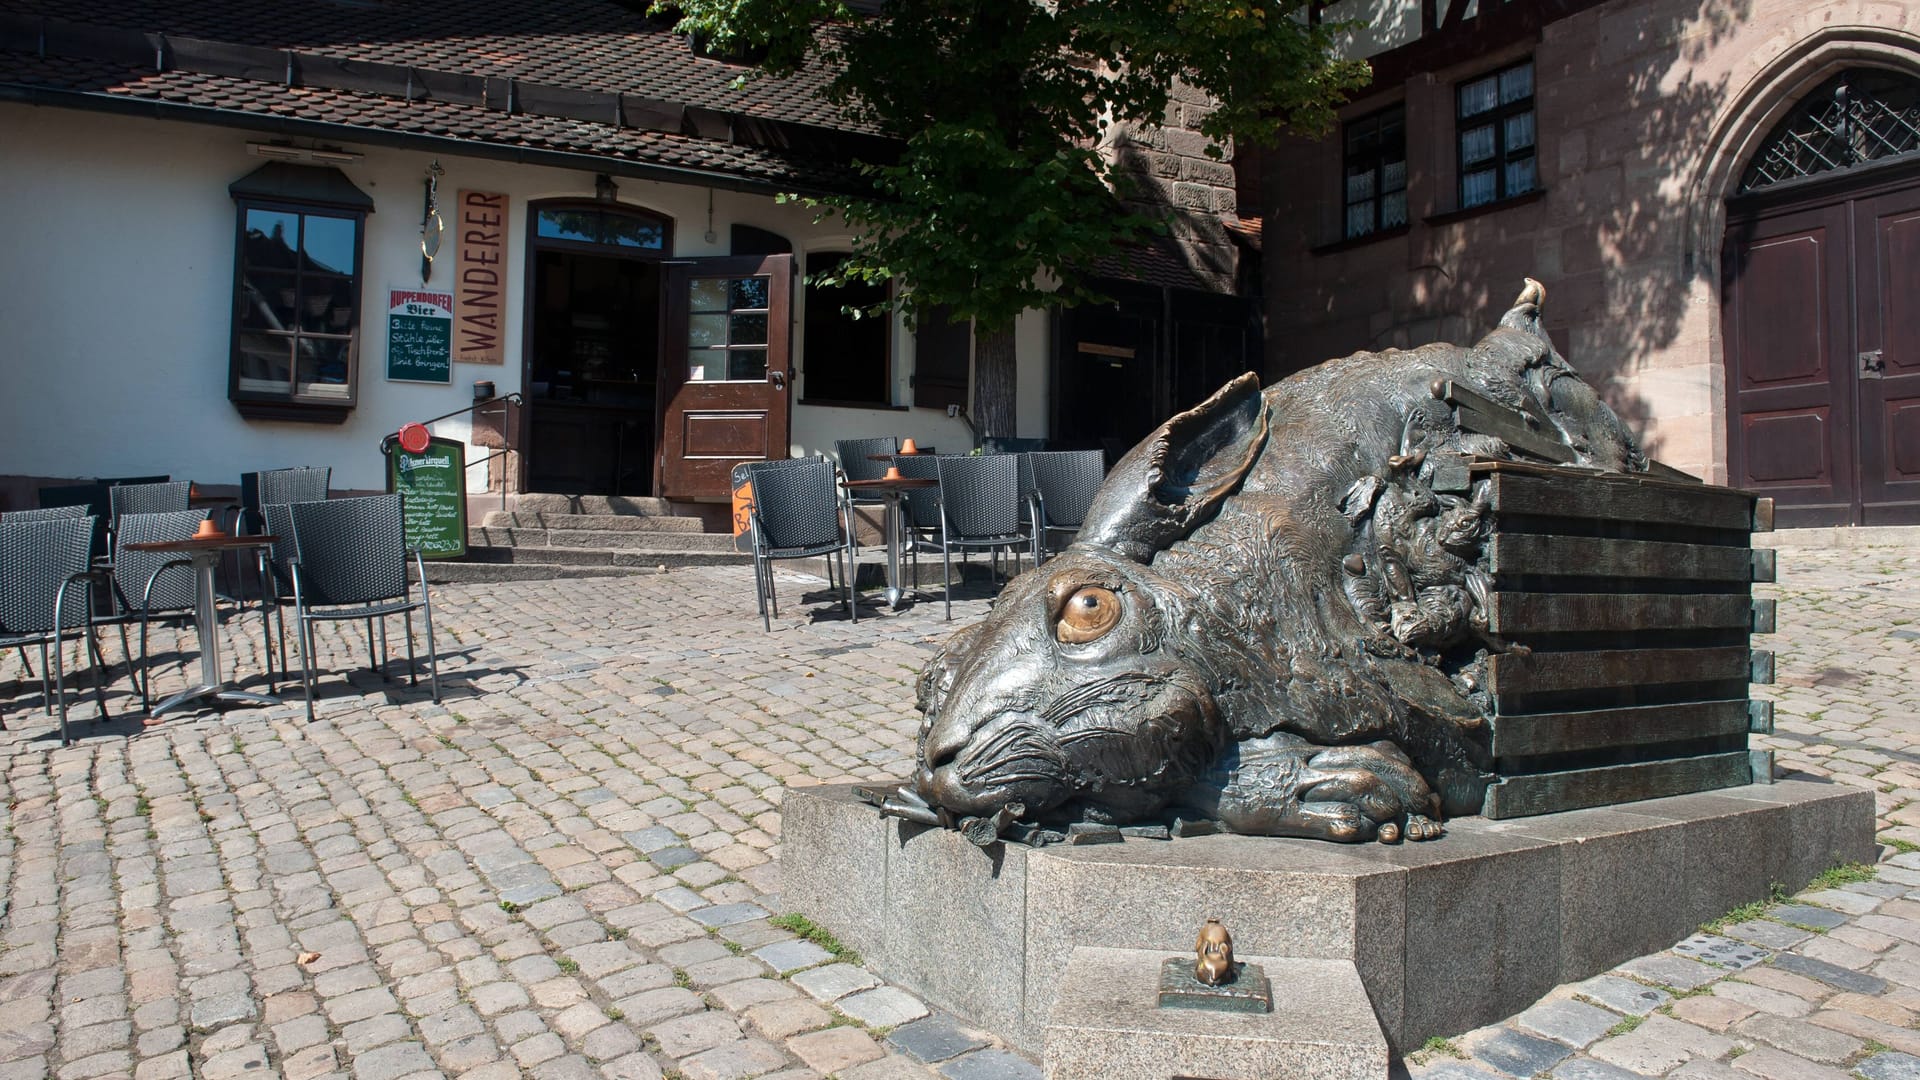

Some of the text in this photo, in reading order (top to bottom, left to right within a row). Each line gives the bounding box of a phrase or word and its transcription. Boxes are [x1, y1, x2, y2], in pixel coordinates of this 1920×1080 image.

[460, 192, 501, 351] WANDERER
[391, 290, 452, 313] HUPPENDORFER
[407, 304, 436, 315] Bier
